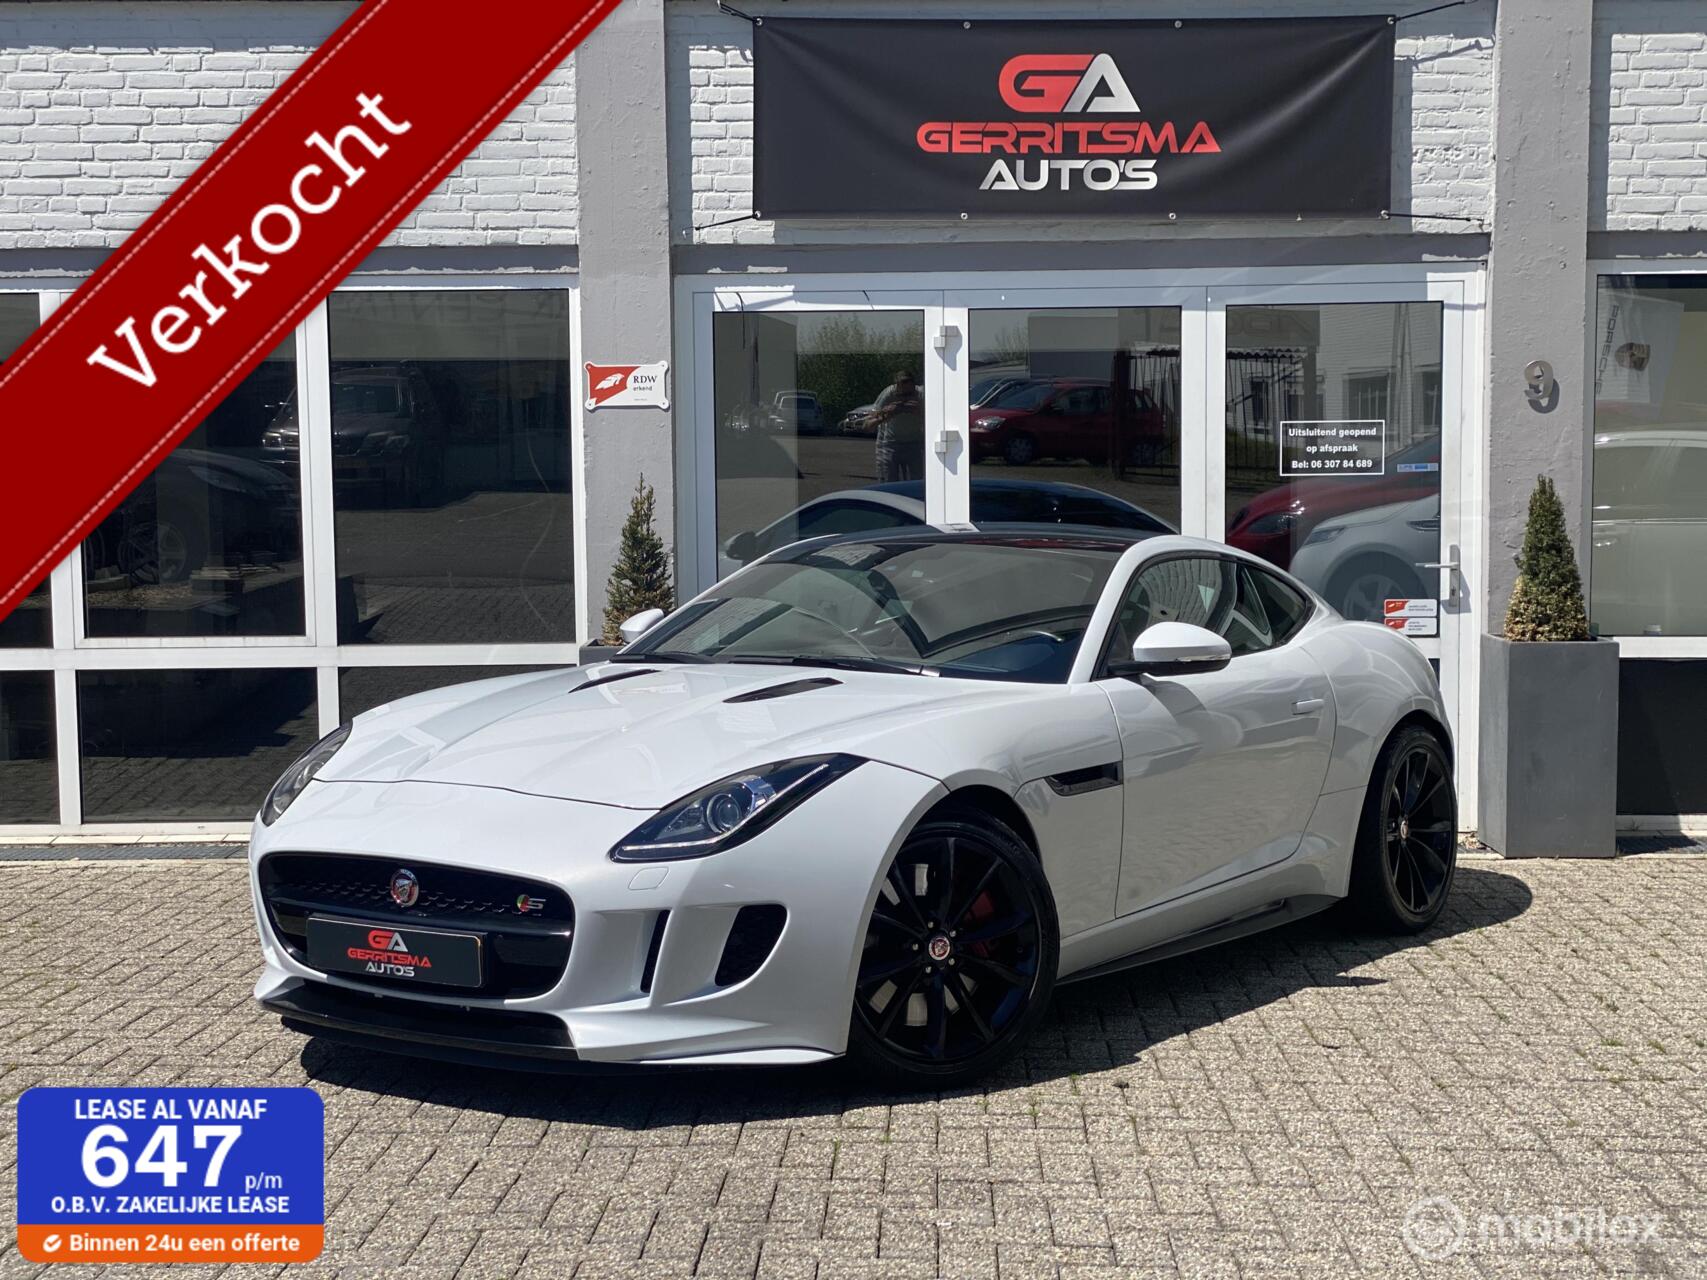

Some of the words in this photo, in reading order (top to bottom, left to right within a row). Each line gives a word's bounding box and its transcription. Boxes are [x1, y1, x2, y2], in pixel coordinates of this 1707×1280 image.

[999, 53, 1141, 113] GA
[917, 121, 1222, 154] GERRITSMA
[979, 158, 1158, 191] AUTO'S
[633, 375, 657, 383] RDW
[1524, 360, 1554, 400] 9
[1288, 428, 1336, 436] Uitsluitend
[1338, 428, 1376, 437] geopend
[1306, 446, 1317, 454] op
[1319, 444, 1358, 453] afspraak
[1291, 460, 1309, 469] Bel:
[1311, 460, 1322, 468] 06
[1324, 460, 1340, 468] 307
[1342, 460, 1354, 468] 84
[1355, 460, 1372, 468] 689
[368, 929, 408, 952] GA
[347, 947, 432, 968] GERRITSMA
